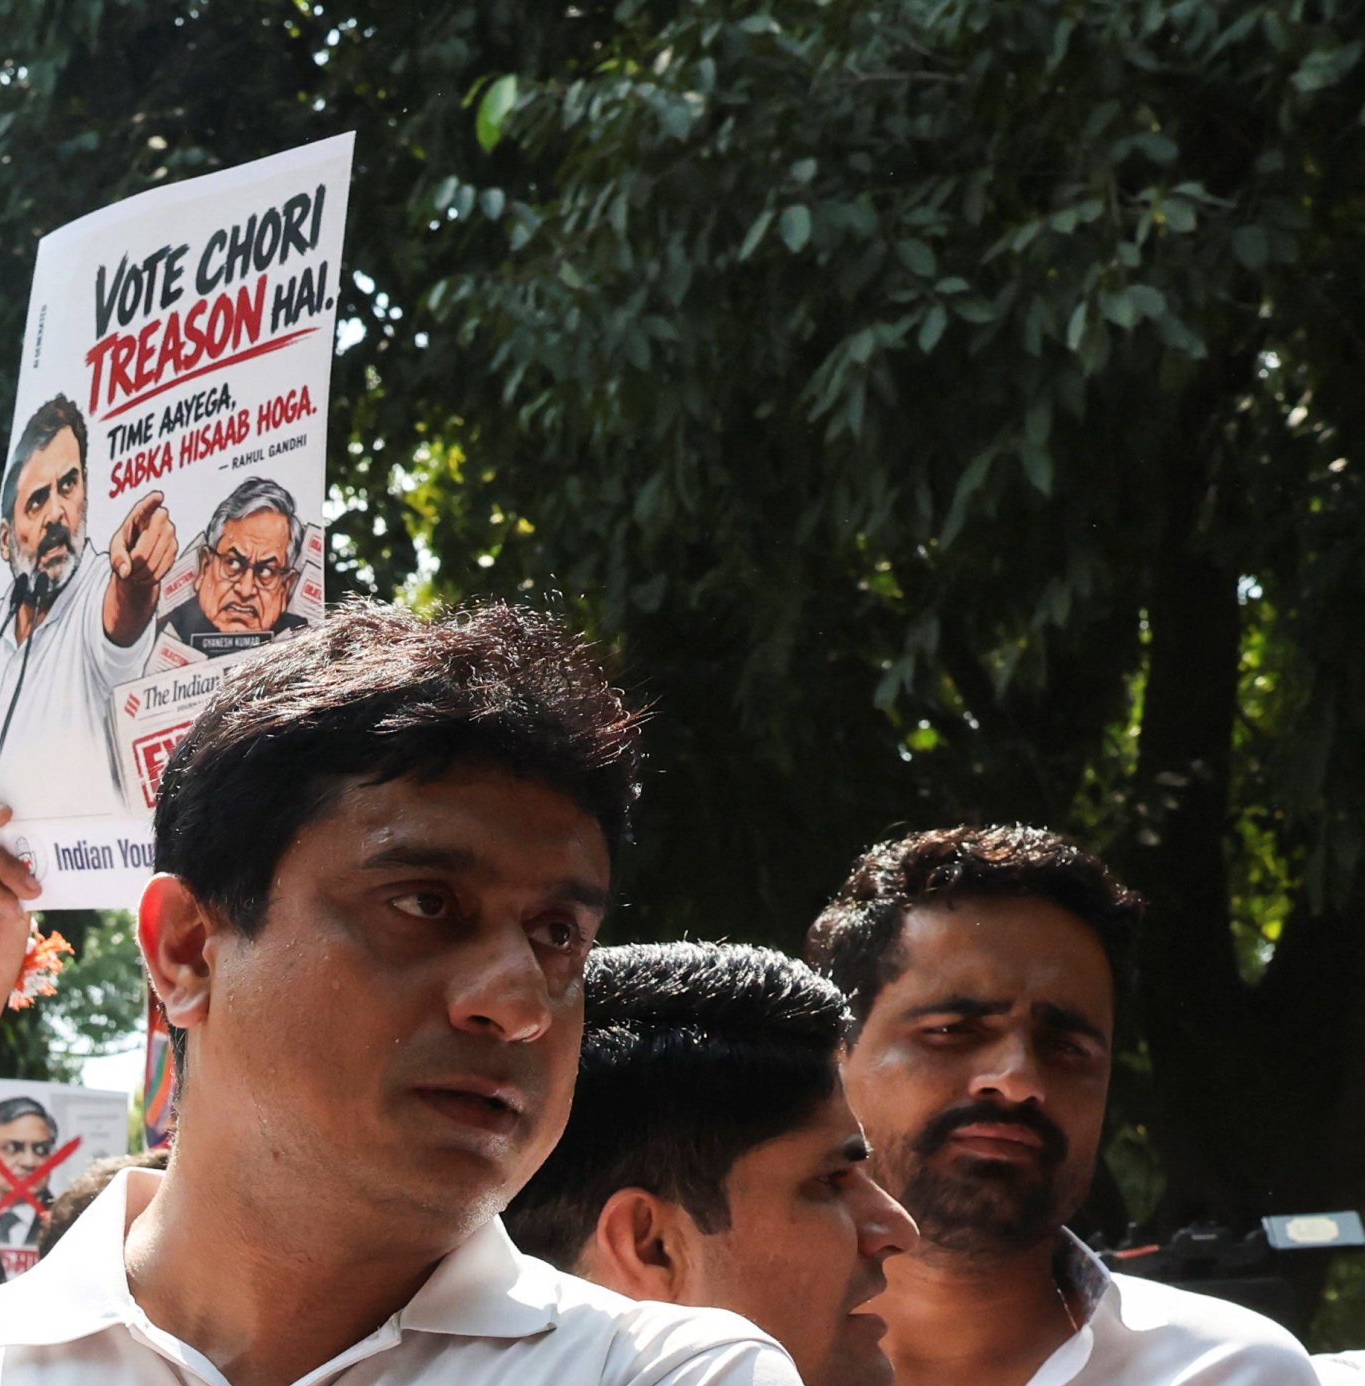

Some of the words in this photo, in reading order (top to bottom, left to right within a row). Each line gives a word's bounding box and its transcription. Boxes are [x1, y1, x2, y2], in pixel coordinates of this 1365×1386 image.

[95, 244, 190, 340] VOTE
[196, 183, 326, 296] CHORI
[86, 273, 267, 416] TREASON
[271, 260, 334, 334] HAI.
[107, 412, 155, 460] TIME
[159, 382, 237, 438] AAYEGA,
[108, 441, 173, 499] SABKA
[179, 408, 250, 468] HISAAB
[257, 385, 317, 436] HOGA.
[232, 451, 265, 470] RAHUL
[268, 434, 307, 459] GANDHI
[202, 637, 233, 648] GYANESH
[143, 685, 170, 710] The
[54, 840, 114, 871] Indian
